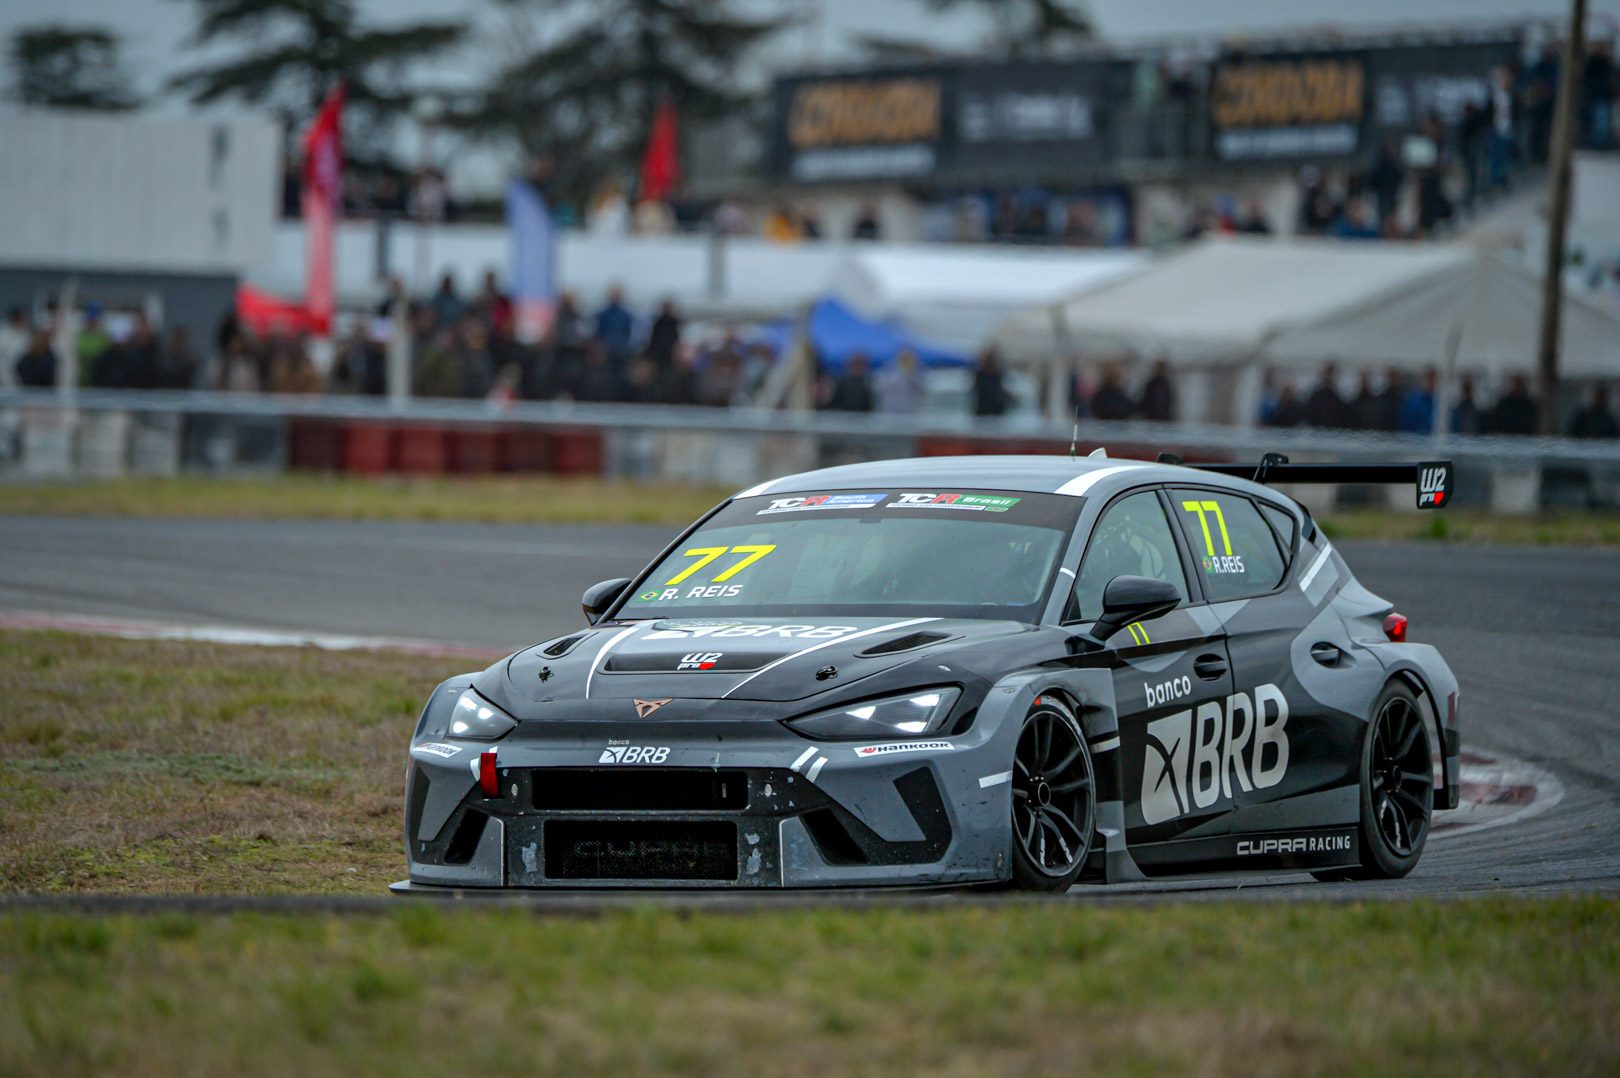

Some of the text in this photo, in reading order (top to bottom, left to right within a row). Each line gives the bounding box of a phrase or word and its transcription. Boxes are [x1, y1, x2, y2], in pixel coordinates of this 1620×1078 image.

[768, 496, 832, 511] TCR
[898, 493, 1012, 505] TCR Brasil
[1182, 501, 1233, 556] 77
[664, 545, 777, 585] 77
[658, 585, 744, 601] R. REIS
[711, 624, 858, 638] BRB
[681, 652, 724, 663] W2
[1144, 675, 1192, 709] banco
[608, 738, 631, 746] banco
[1191, 683, 1290, 809] BRB
[622, 746, 671, 764] BRB
[1237, 836, 1351, 856] CUPRA RACING
